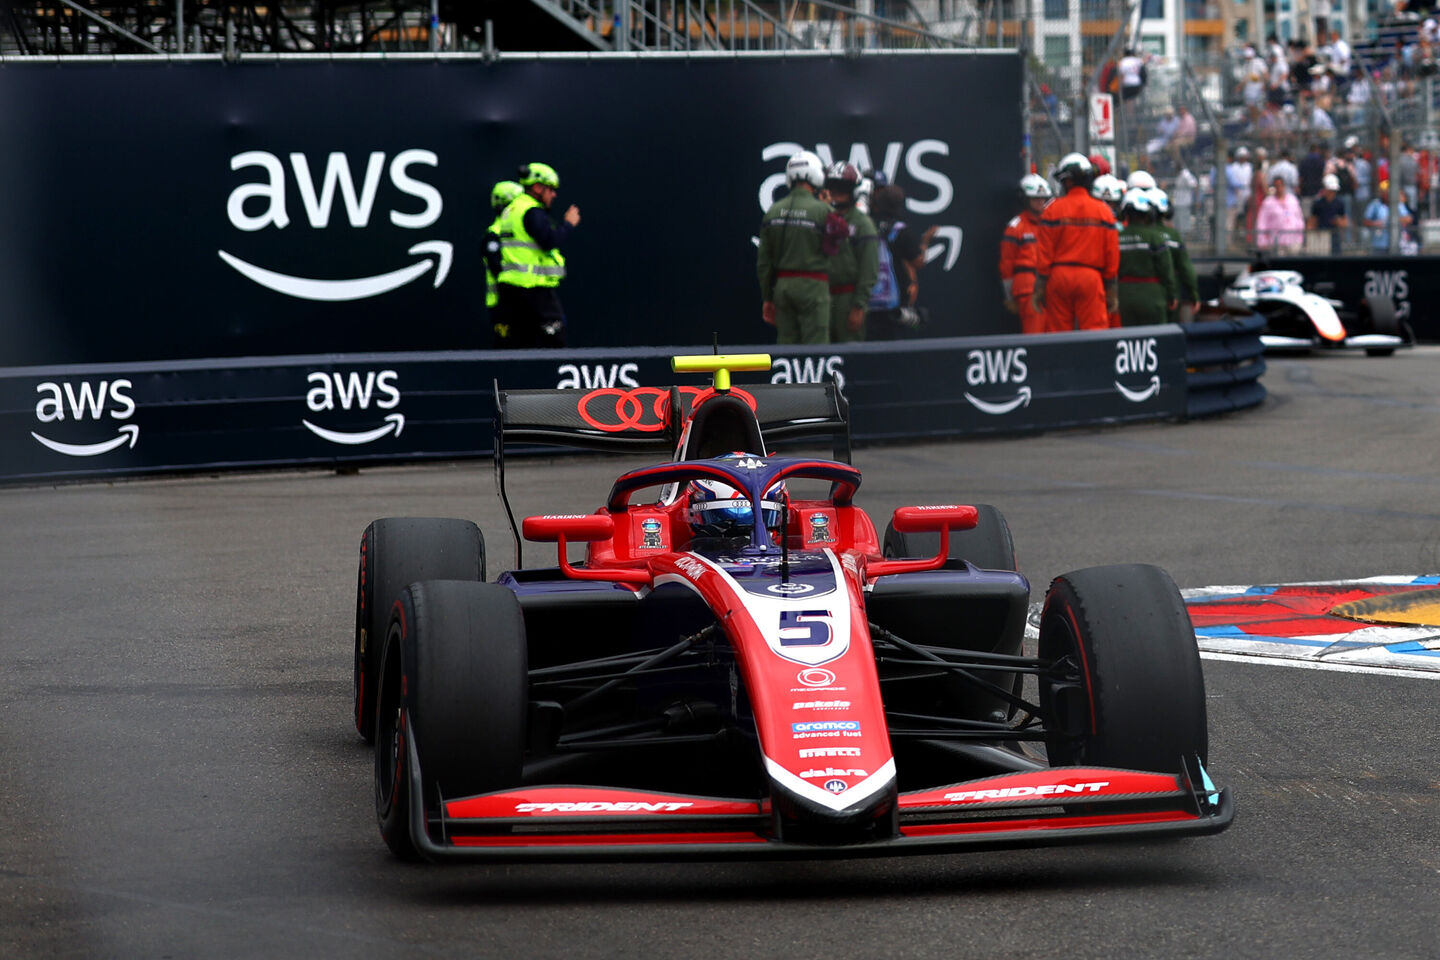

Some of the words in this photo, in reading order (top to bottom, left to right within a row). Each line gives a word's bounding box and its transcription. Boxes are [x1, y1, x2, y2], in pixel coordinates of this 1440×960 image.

[227, 149, 443, 231] aws
[1365, 270, 1409, 300] aws
[966, 348, 1028, 385] aws
[1115, 338, 1158, 374] aws
[36, 379, 135, 422] aws
[306, 370, 400, 411] aws
[779, 610, 833, 647] 5
[793, 730, 841, 739] advanced
[842, 729, 862, 737] fuel
[795, 721, 857, 731] aramco
[515, 801, 694, 812] TRIDENT
[944, 781, 1110, 801] TRIDENT
